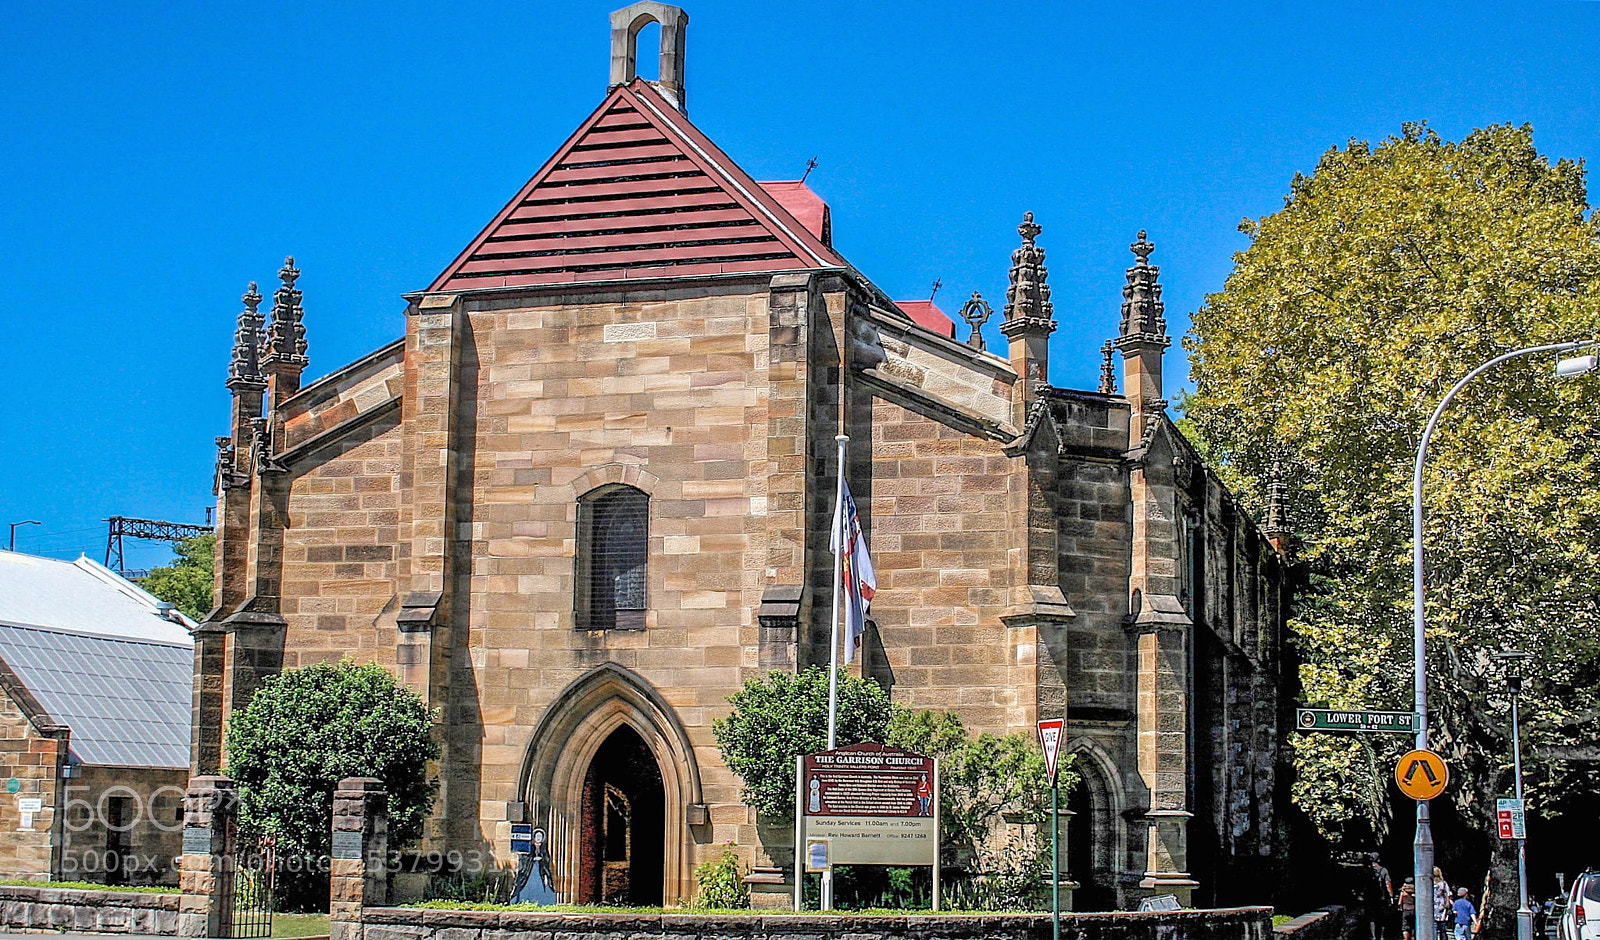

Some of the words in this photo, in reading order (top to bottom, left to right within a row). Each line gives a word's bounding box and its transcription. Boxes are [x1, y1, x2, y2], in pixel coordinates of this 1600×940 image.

[1327, 713, 1362, 724] LOWER
[1367, 714, 1394, 725] FORT
[1398, 715, 1412, 726] ST
[1045, 731, 1056, 742] GIVE
[815, 755, 835, 764] THE
[836, 756, 884, 765] GARRISON
[885, 757, 924, 766] CHURCH
